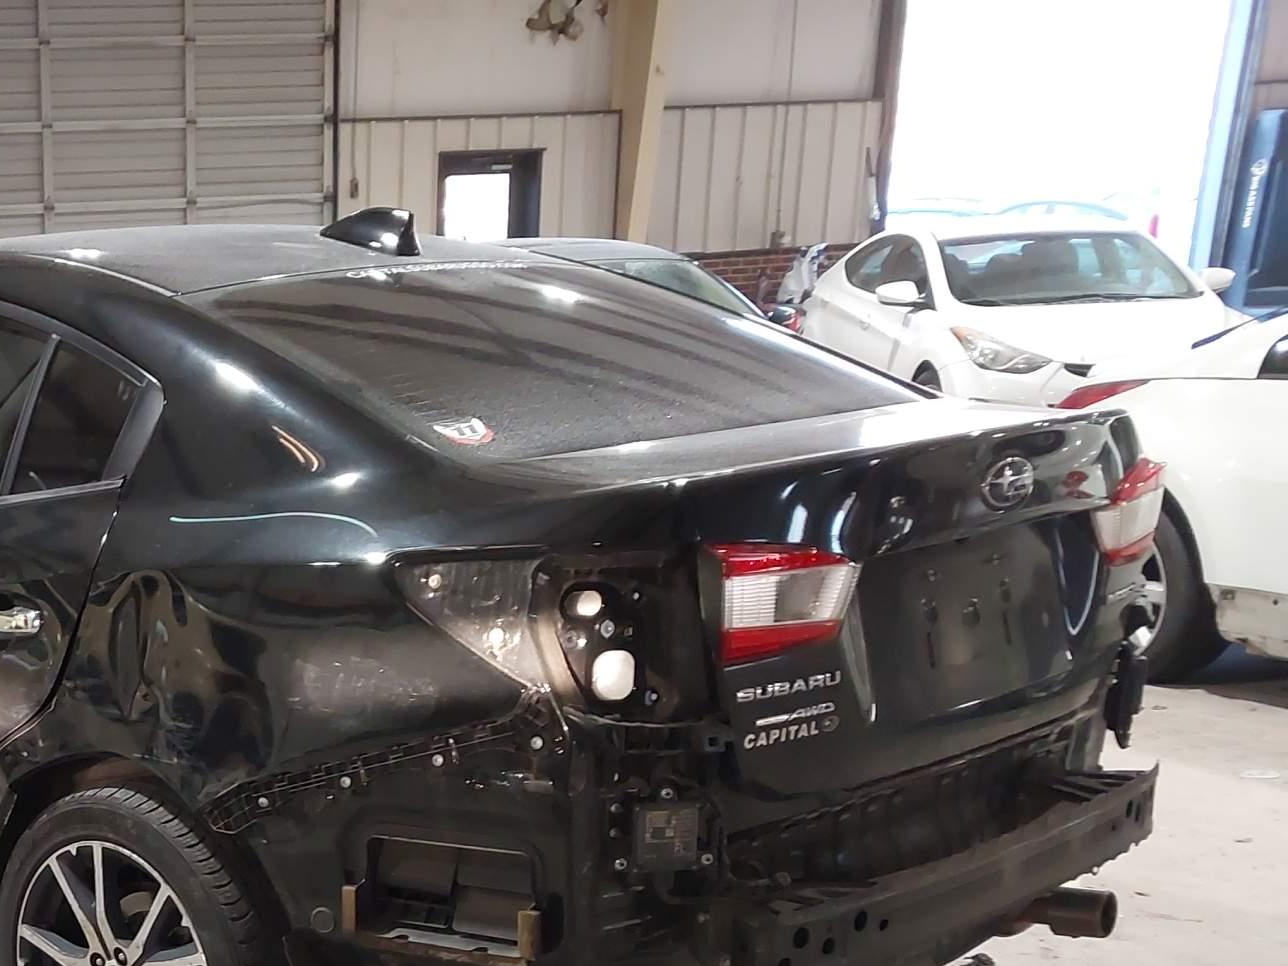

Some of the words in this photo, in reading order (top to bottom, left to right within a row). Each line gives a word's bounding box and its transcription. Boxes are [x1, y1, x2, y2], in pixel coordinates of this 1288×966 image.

[736, 670, 841, 702] SUBARU
[791, 702, 836, 720] AWD
[743, 720, 820, 749] CAPITAL
